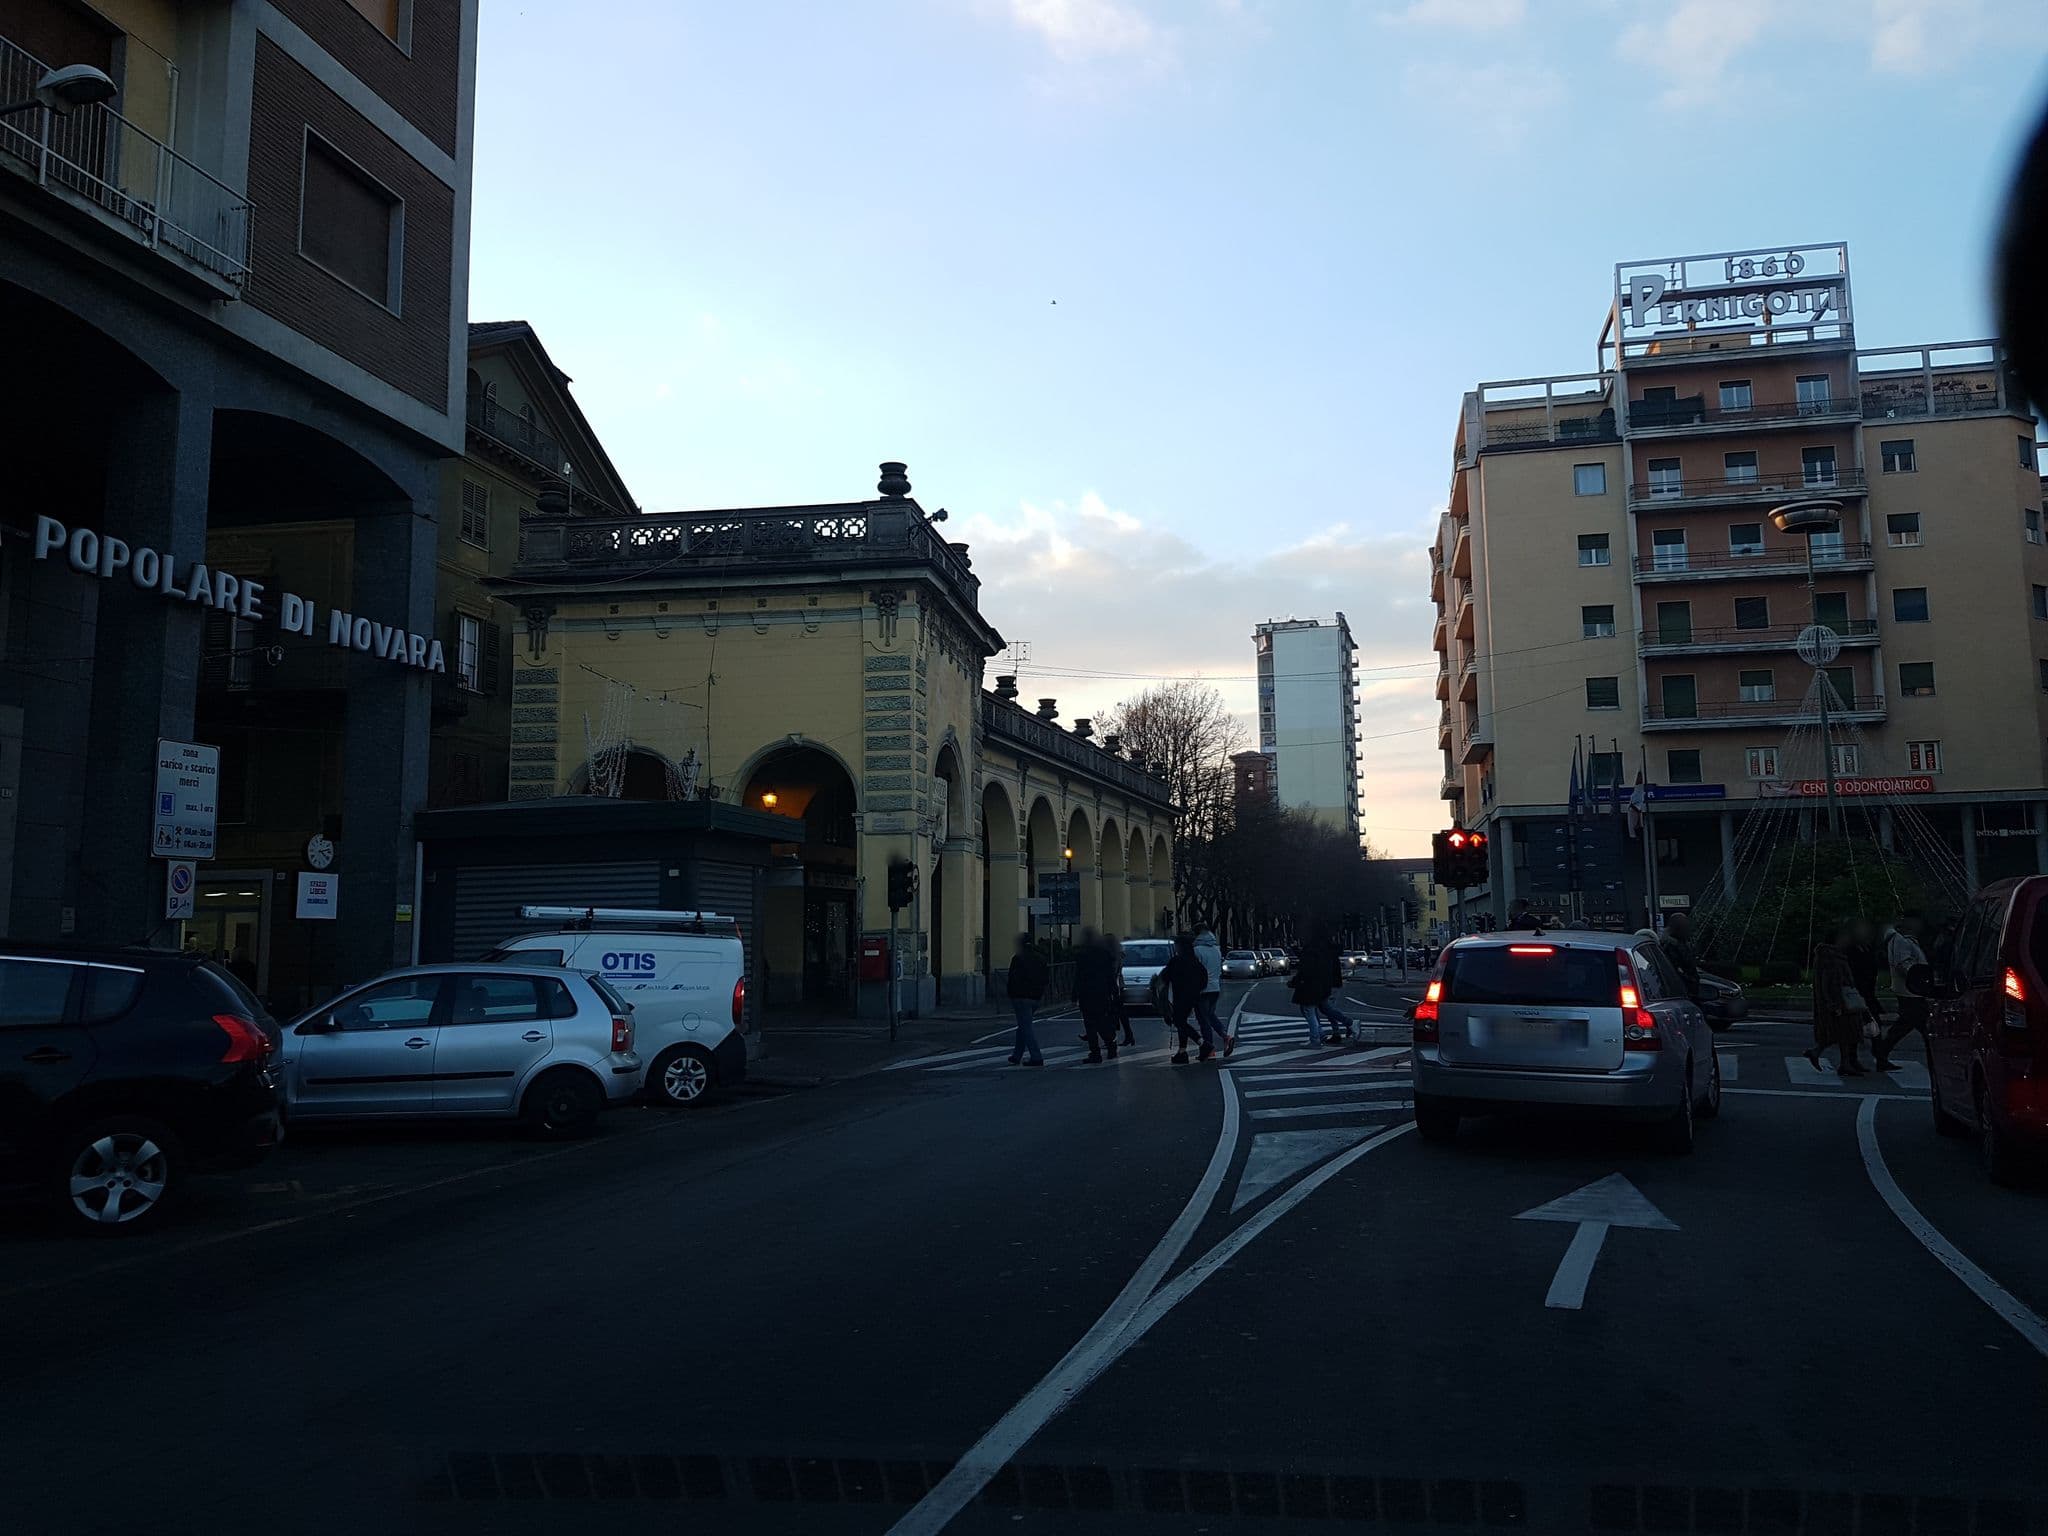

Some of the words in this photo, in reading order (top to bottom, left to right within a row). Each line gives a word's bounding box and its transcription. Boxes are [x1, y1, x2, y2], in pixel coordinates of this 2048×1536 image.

[1725, 254, 1805, 281] 1860
[1629, 273, 1838, 328] PERNIGOTTI
[34, 514, 265, 622] POPOLARE
[280, 592, 315, 637] DI
[328, 609, 446, 673] NOVARA
[182, 748, 199, 758] zona
[160, 758, 183, 770] carico
[190, 763, 216, 775] scarico
[179, 777, 200, 787] merci
[1802, 783, 1842, 794] CENTO
[1845, 779, 1930, 793] ODONTOIATRICO
[602, 952, 656, 971] OTIS
